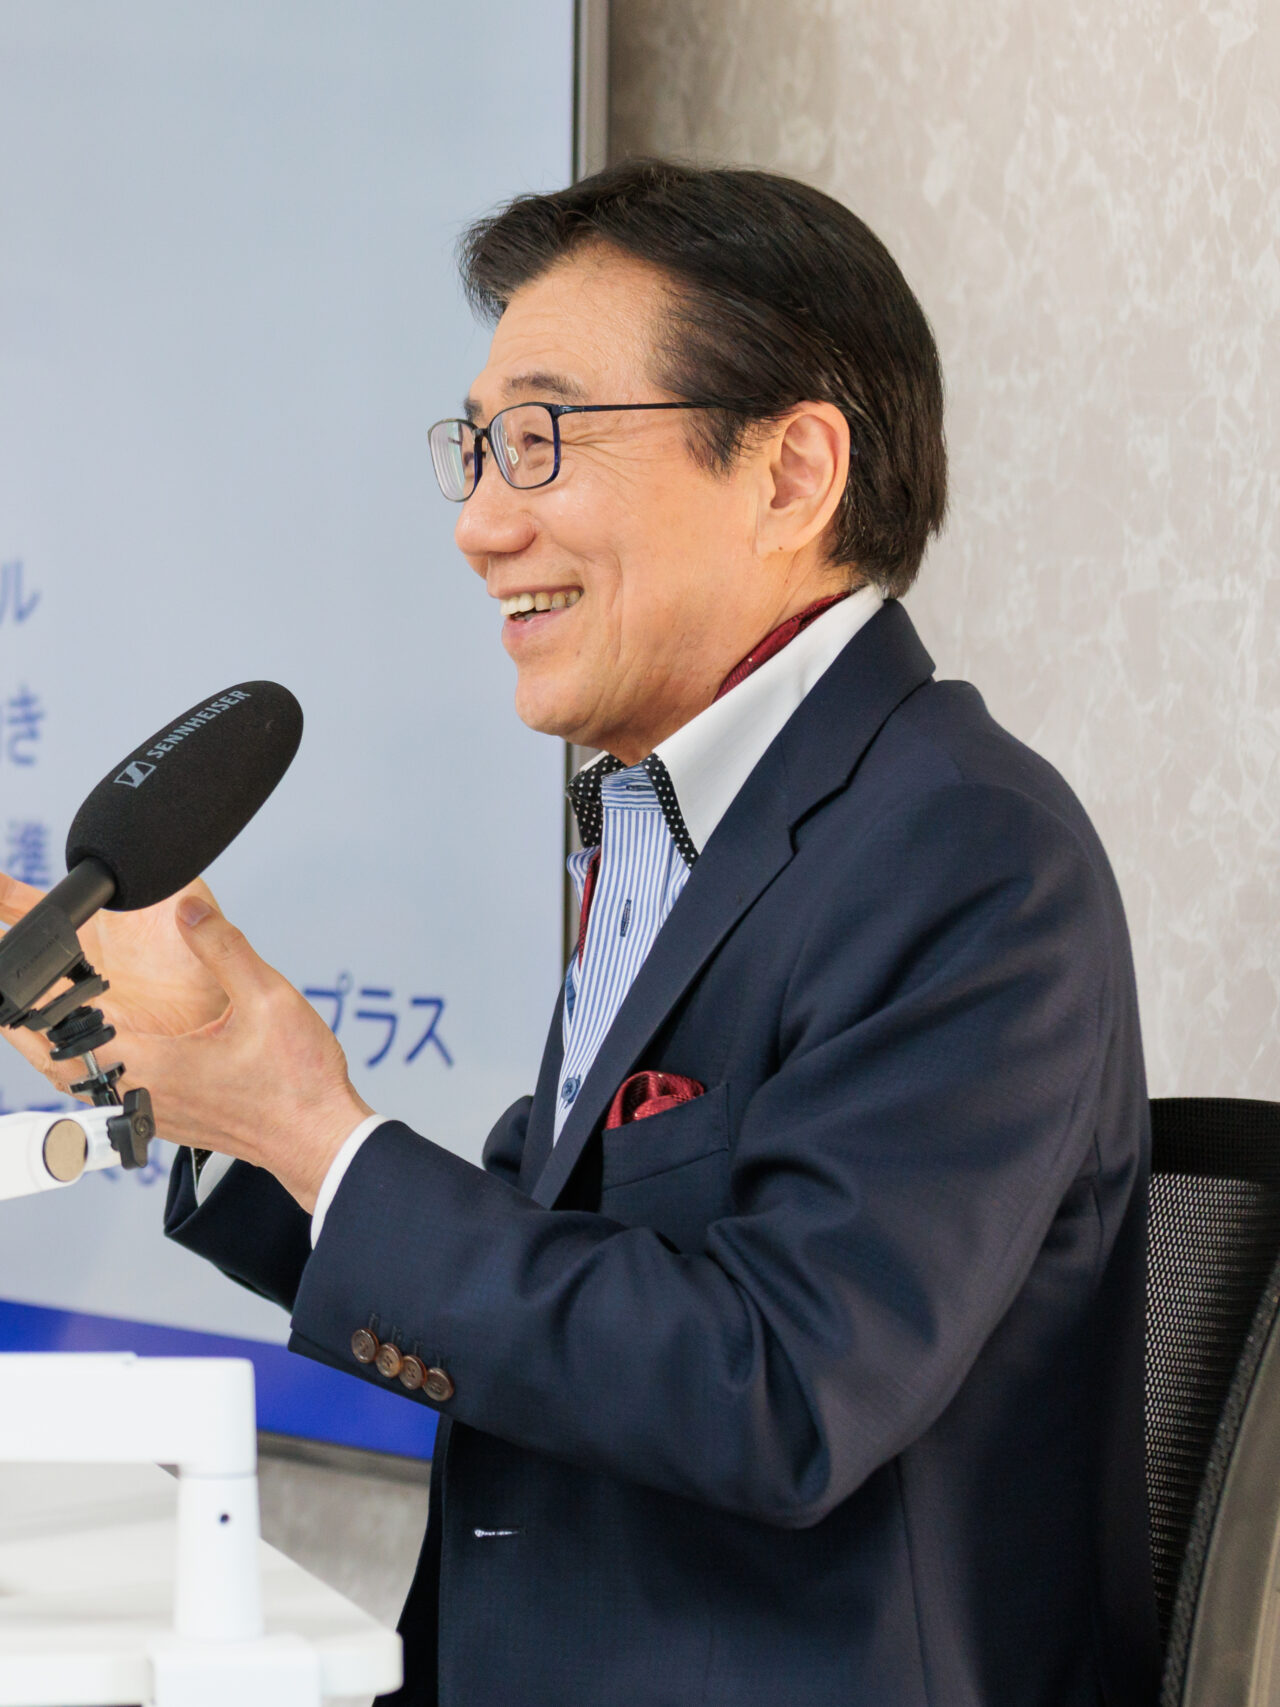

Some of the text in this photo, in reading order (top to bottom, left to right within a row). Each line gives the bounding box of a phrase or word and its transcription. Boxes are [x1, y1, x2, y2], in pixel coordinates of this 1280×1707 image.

[146, 690, 253, 760] SENNHEISER
[303, 972, 455, 1068] プラス
